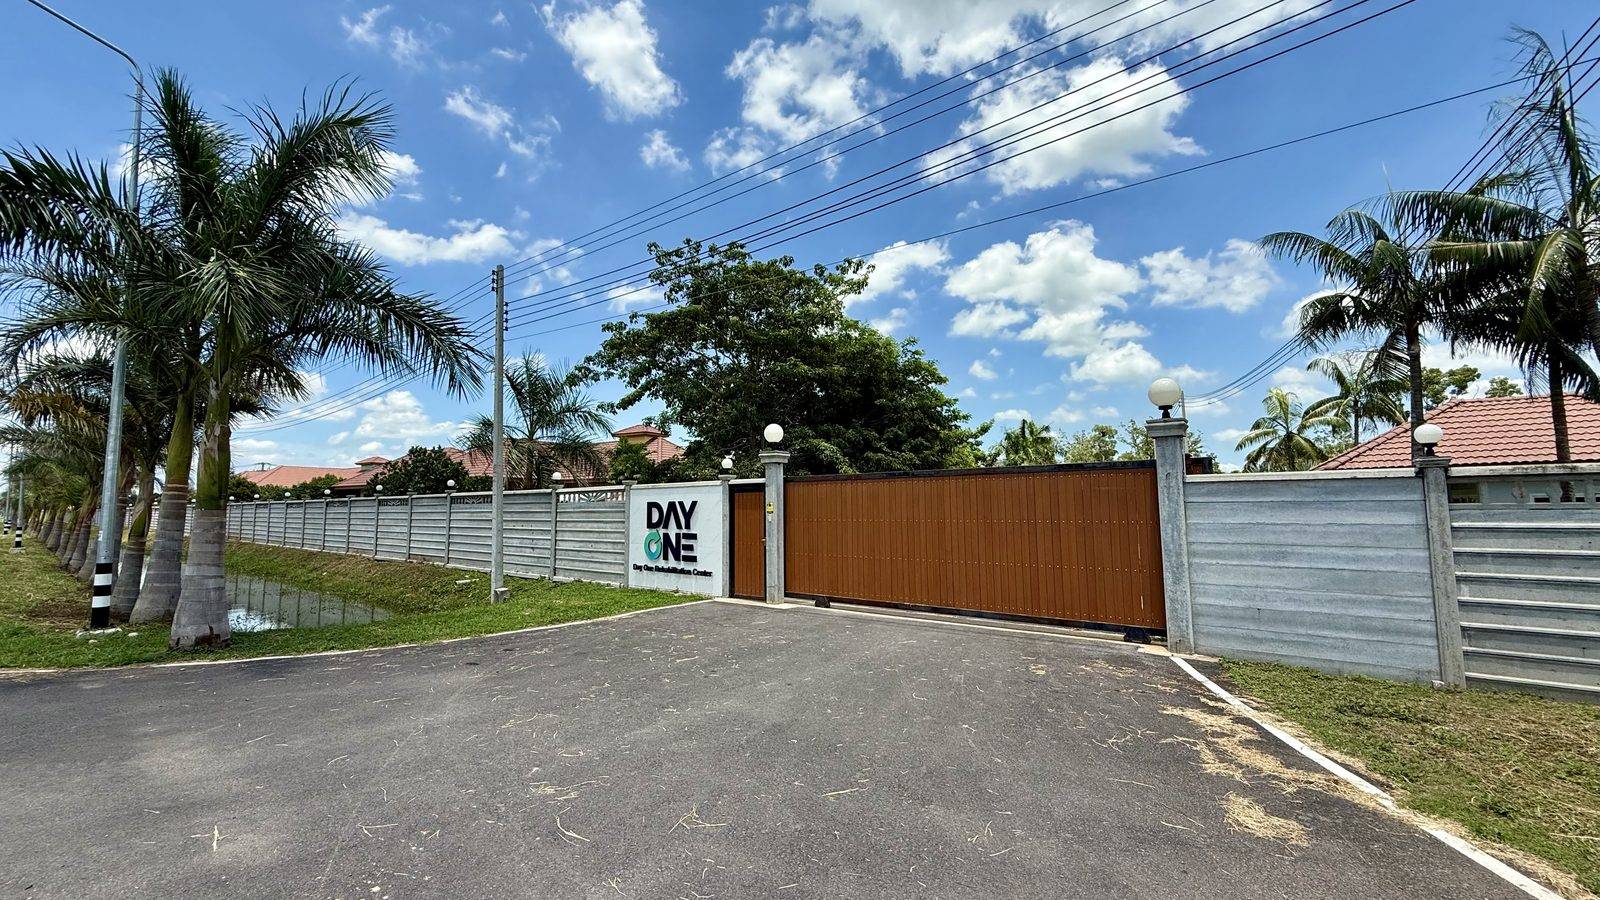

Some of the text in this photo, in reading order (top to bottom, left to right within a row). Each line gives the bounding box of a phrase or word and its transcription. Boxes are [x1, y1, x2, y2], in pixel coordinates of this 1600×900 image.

[646, 501, 698, 529] DAY
[644, 530, 697, 562] ONE
[655, 565, 692, 575] Rehabilitation
[692, 569, 713, 577] Center
